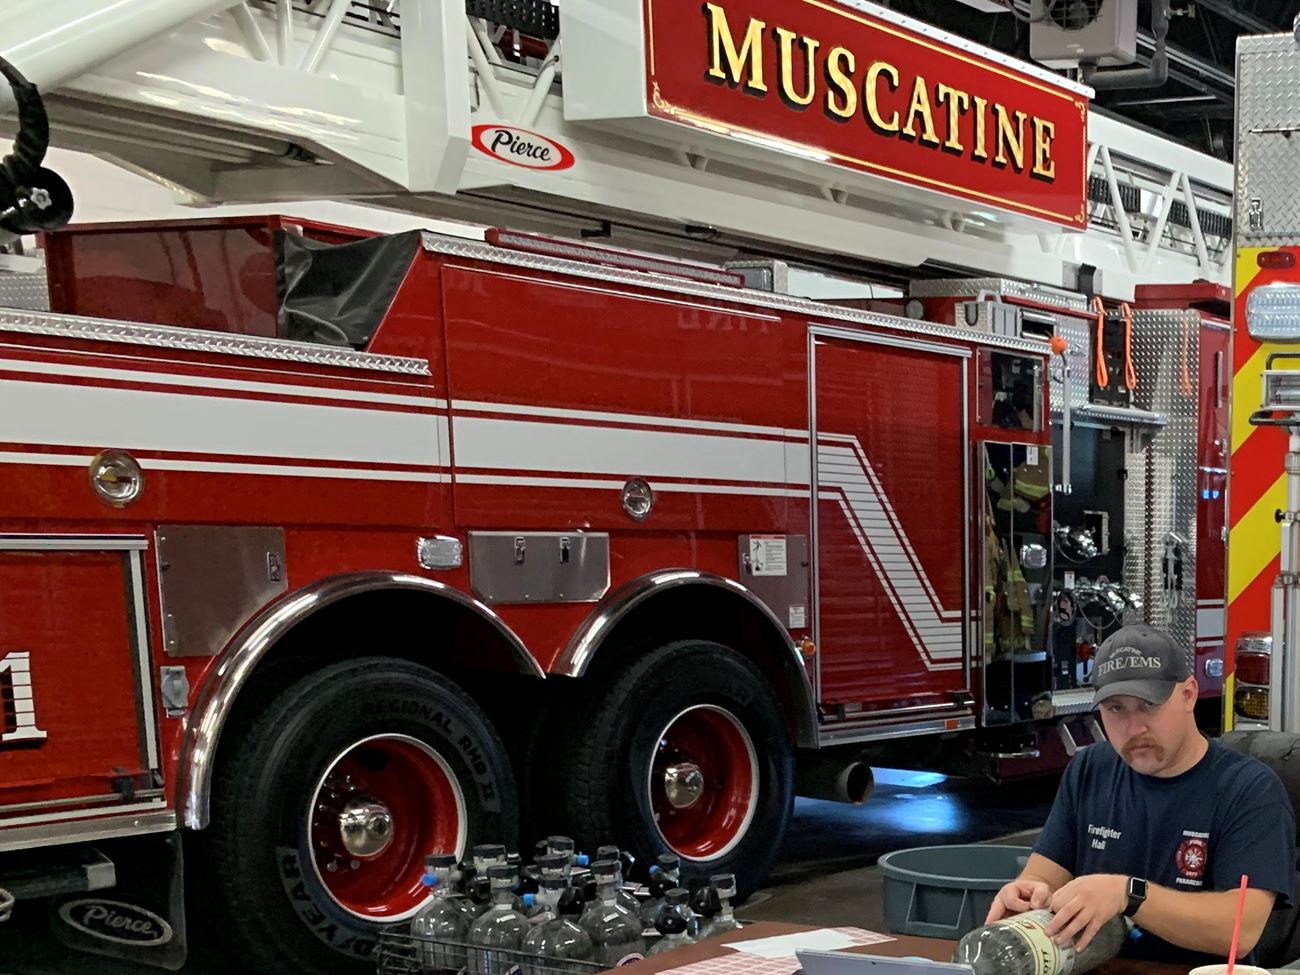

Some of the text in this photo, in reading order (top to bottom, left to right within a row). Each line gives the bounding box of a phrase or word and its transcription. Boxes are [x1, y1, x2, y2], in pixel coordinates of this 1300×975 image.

[705, 2, 1056, 181] MUSCATINE
[491, 130, 551, 161] Pierce
[1097, 656, 1161, 677] FIRE/EMS
[1088, 823, 1121, 840] Firefighter
[1091, 838, 1106, 850] Hall
[83, 904, 153, 935] Pierce
